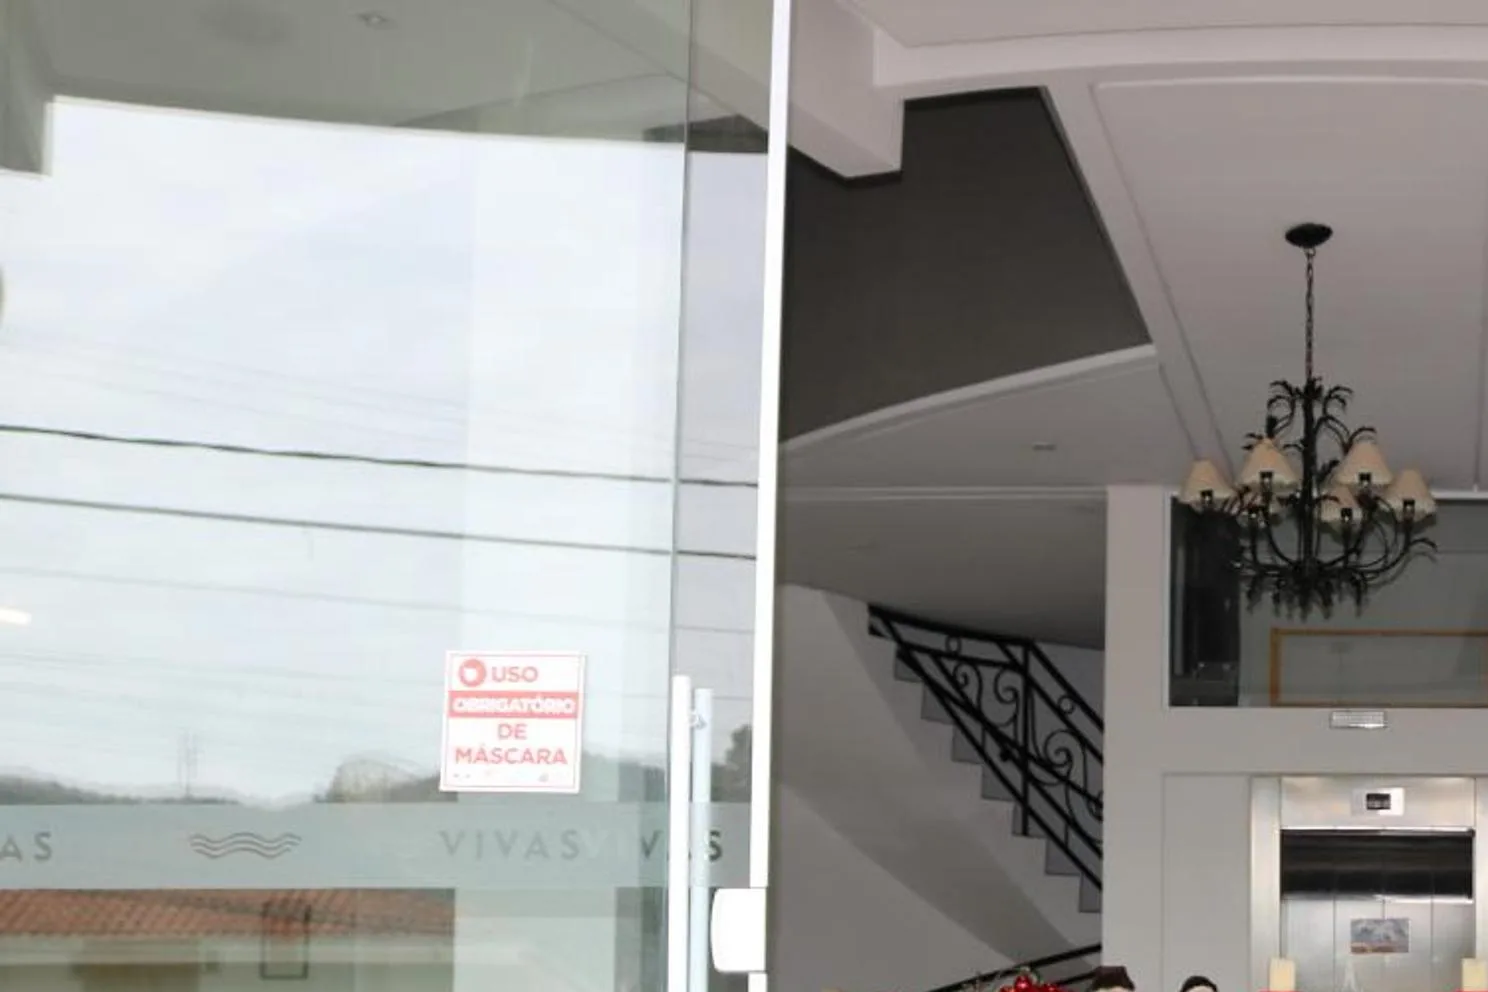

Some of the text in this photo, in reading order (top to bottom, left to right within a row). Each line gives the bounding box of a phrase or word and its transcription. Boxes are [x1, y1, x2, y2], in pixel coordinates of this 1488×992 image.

[491, 666, 539, 683] USO
[497, 723, 528, 740] DE
[455, 743, 568, 765] MÁSCARA
[438, 829, 581, 861] VIVAS
